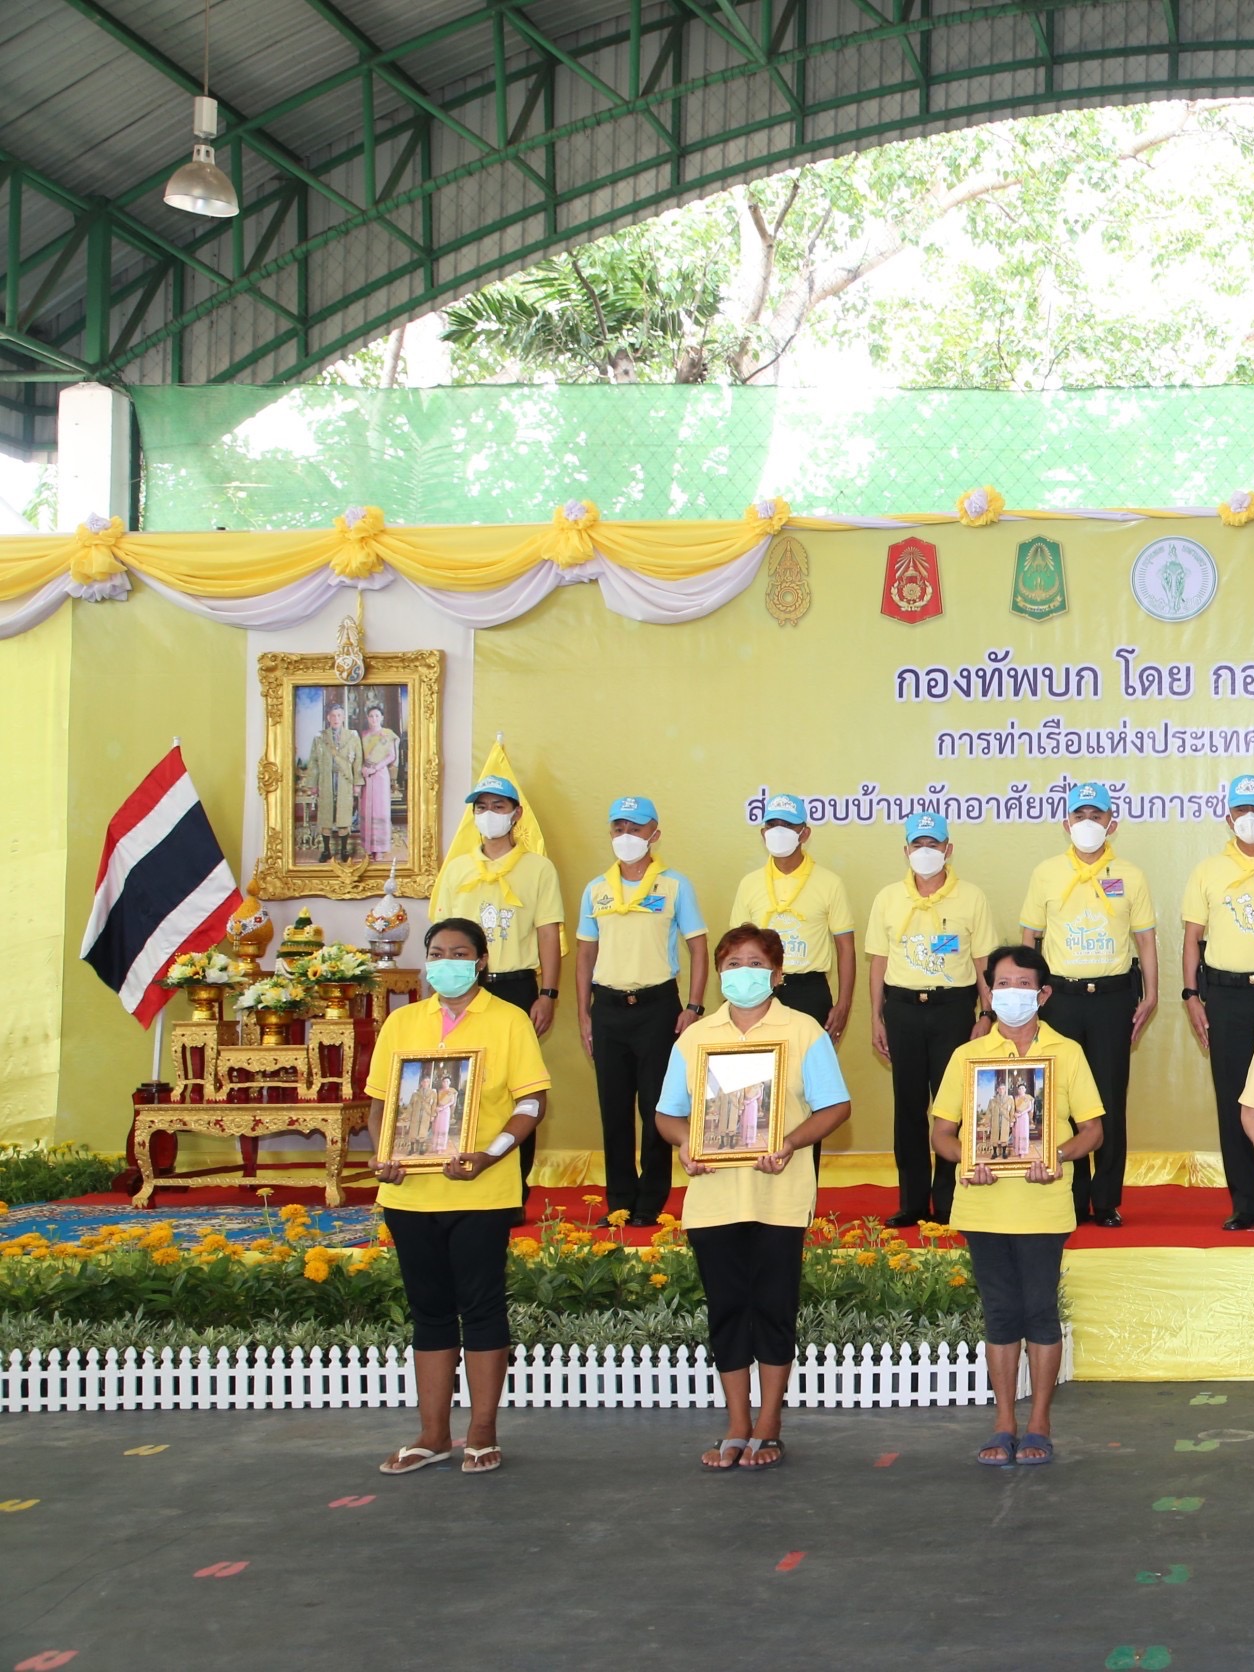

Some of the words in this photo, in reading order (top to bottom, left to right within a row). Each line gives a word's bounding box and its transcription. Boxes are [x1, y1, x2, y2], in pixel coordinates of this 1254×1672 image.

[896, 650, 1099, 699] กองทัพบก
[1115, 648, 1191, 697] โดย
